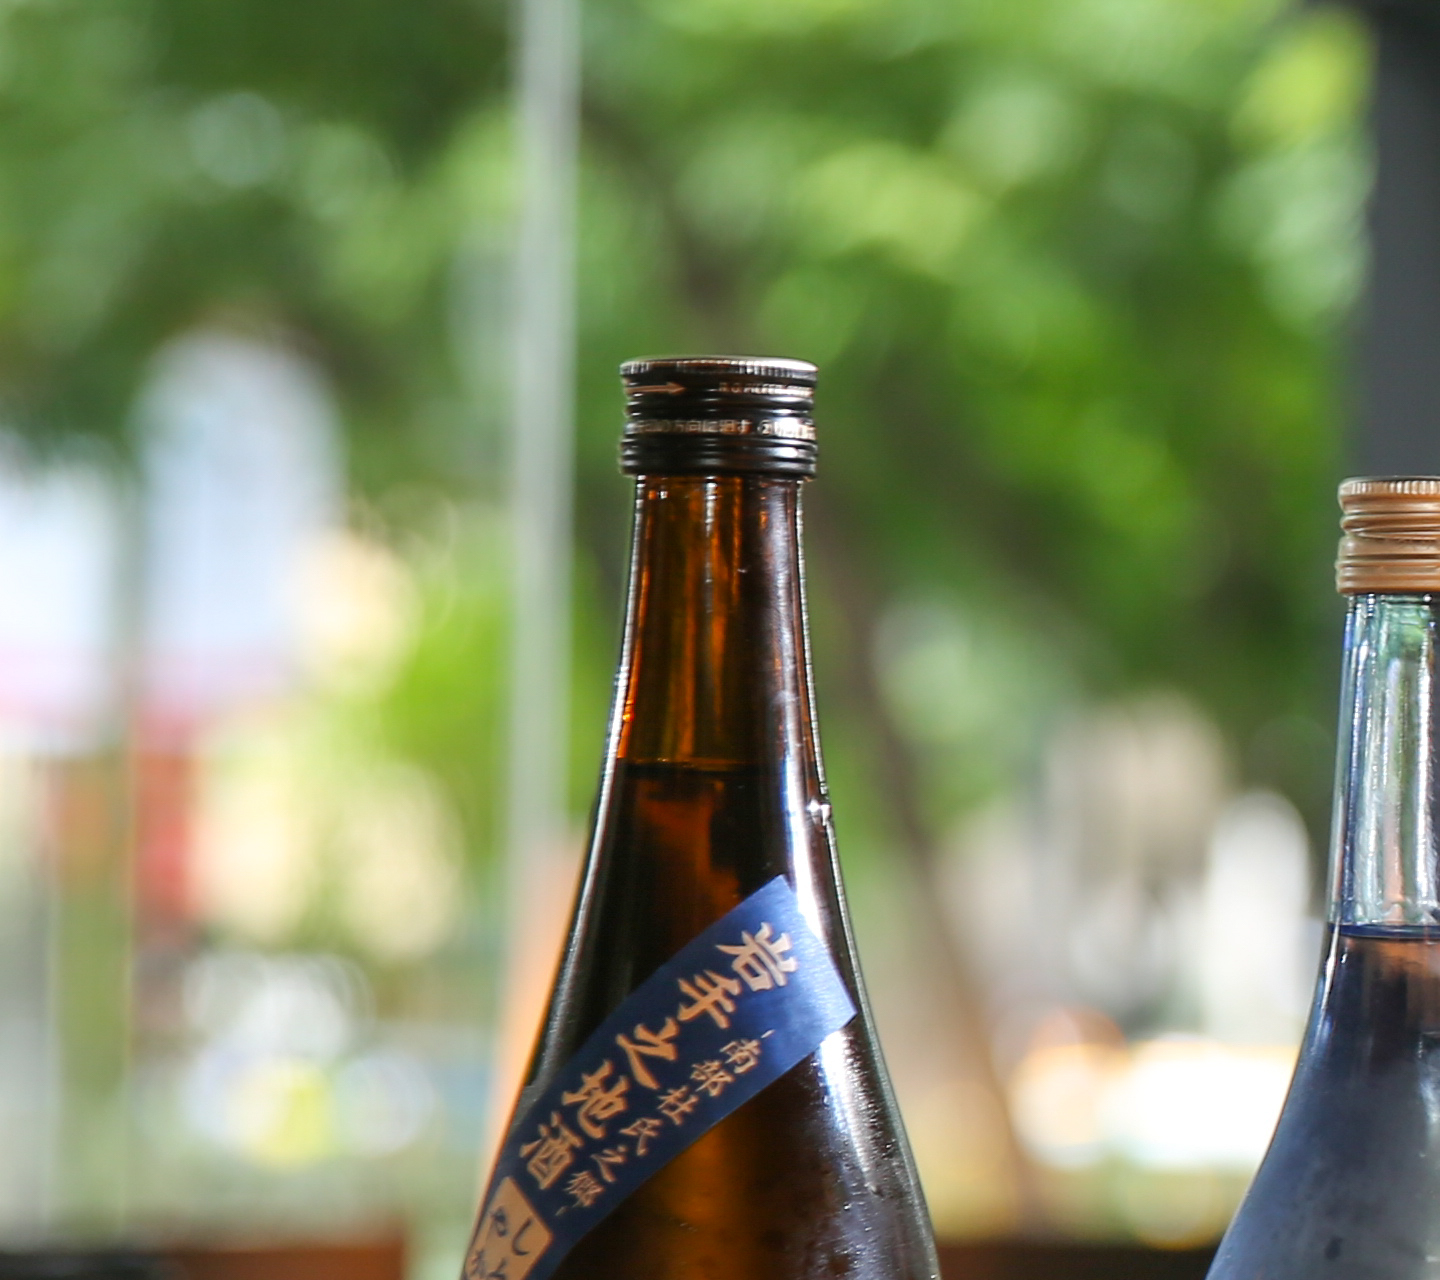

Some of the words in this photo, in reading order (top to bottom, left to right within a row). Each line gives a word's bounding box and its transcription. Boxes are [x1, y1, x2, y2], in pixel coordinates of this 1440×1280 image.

[519, 921, 798, 1190] 岩手之地酒
